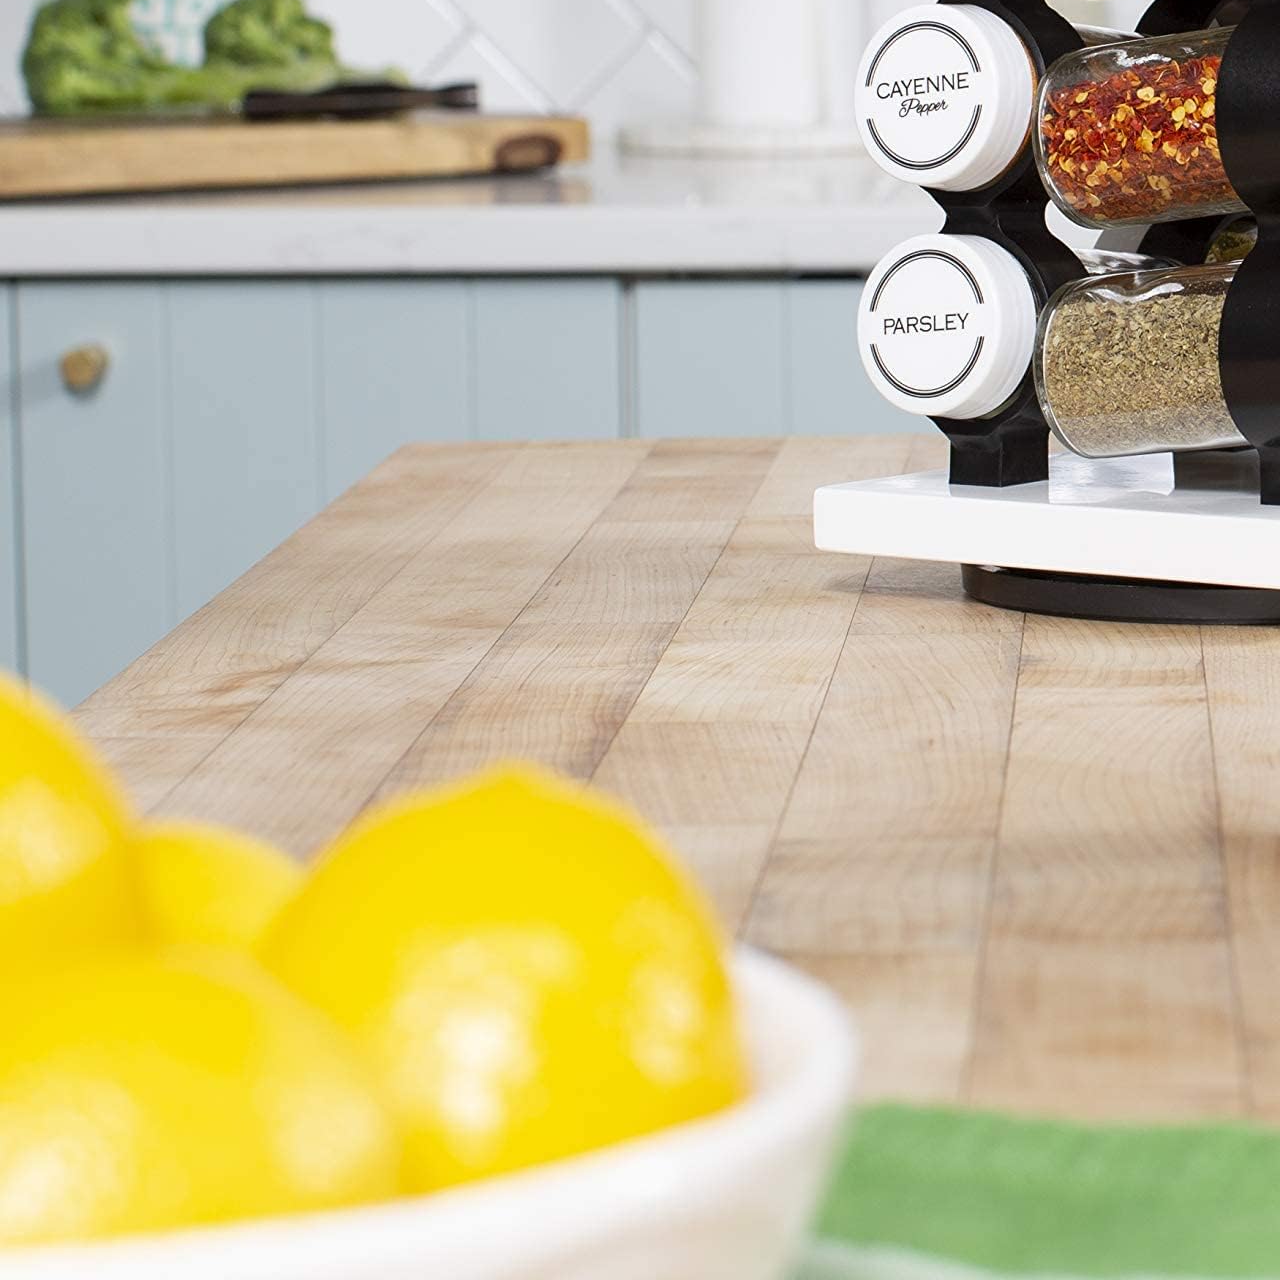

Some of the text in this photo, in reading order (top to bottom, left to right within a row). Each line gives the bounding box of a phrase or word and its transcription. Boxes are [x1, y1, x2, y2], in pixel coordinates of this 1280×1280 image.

[876, 72, 970, 100] CAYENNE
[898, 98, 949, 118] Pepper
[883, 312, 969, 335] PARSLEY
